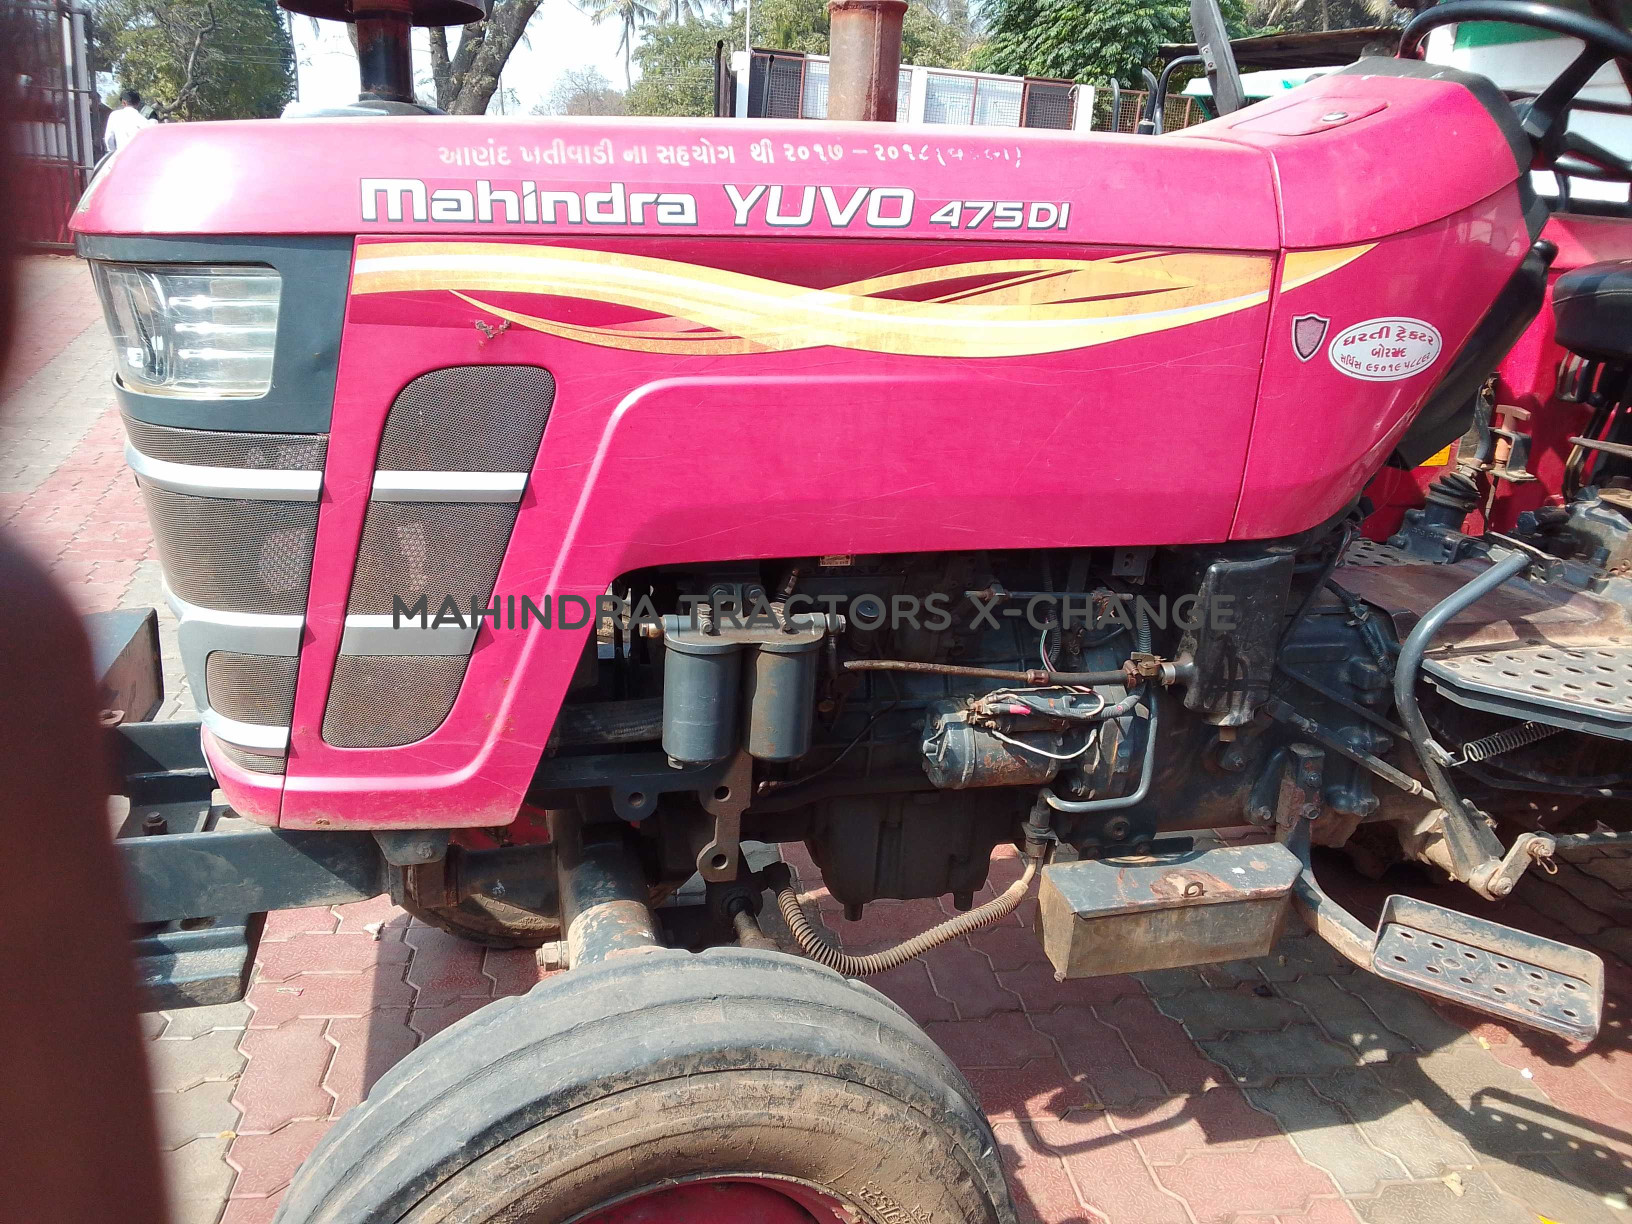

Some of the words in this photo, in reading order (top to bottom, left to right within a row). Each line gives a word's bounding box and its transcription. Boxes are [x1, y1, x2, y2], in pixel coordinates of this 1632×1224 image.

[438, 138, 512, 166] આણંદ
[623, 144, 648, 164] ના
[657, 137, 735, 166] સહયોગ
[750, 138, 774, 163] થી
[360, 178, 698, 226] Mahindra
[723, 184, 915, 229] YUVO
[1343, 326, 1391, 346] ધરતી
